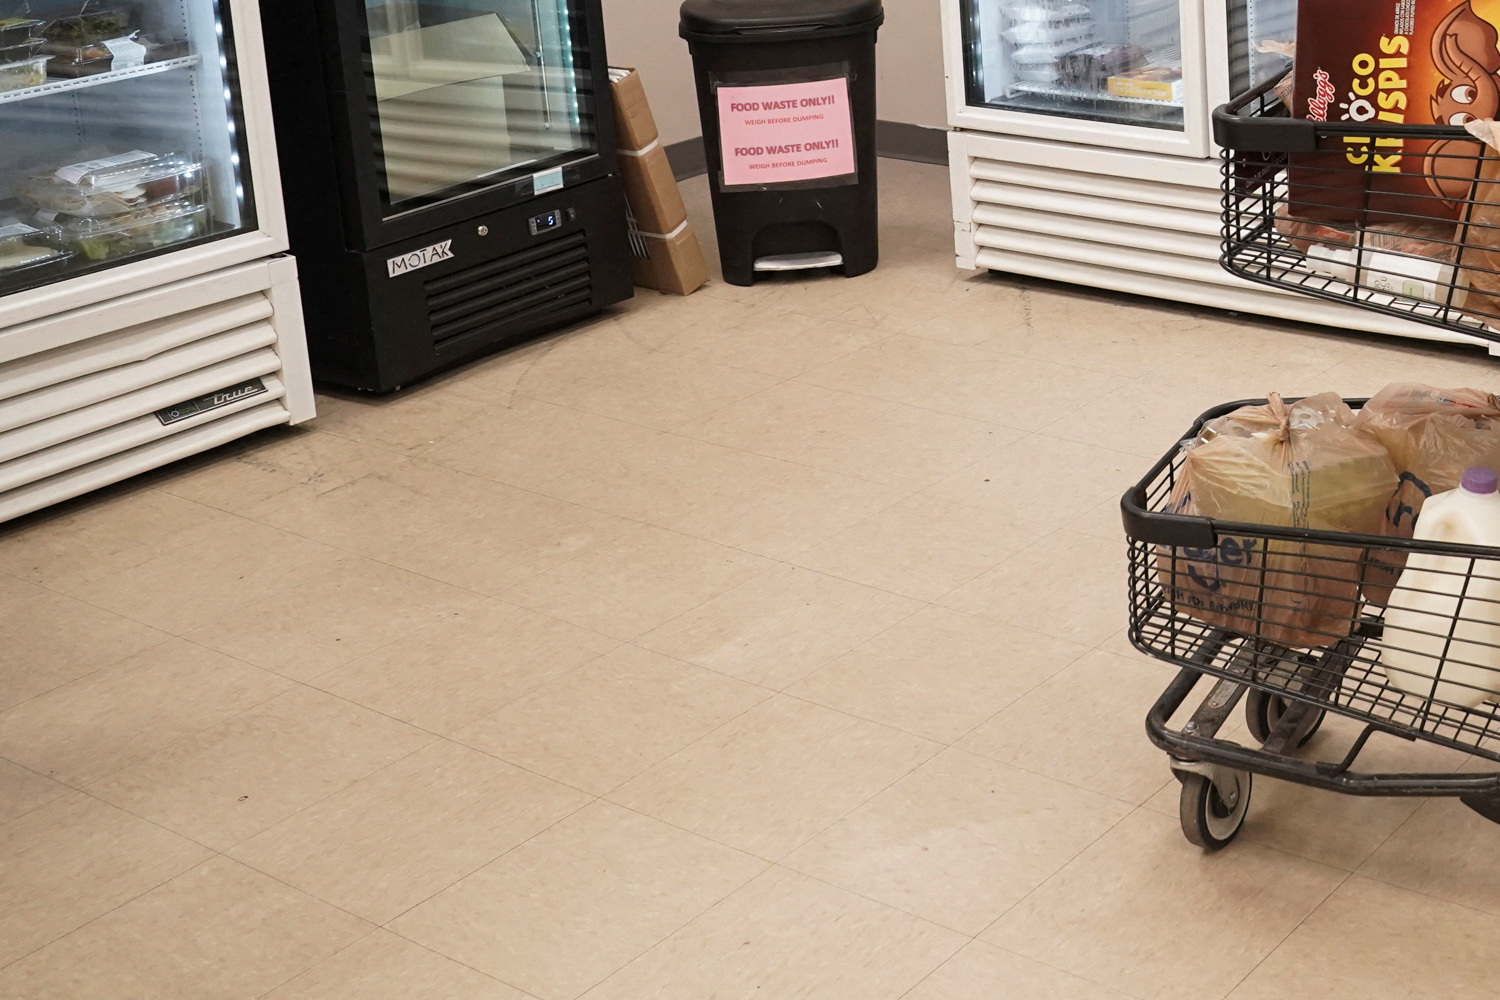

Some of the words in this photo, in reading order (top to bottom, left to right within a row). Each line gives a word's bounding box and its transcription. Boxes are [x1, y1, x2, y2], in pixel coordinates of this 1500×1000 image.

[731, 103, 759, 112] FOOD
[762, 100, 797, 110] WASTE
[800, 95, 834, 107] ONLY!!
[1306, 69, 1335, 122] ellogg's
[735, 147, 764, 156] FOOD
[766, 144, 801, 154] WASTE
[804, 139, 838, 151] ONLY!!
[392, 242, 450, 274] MOTAK
[203, 386, 258, 404] true
